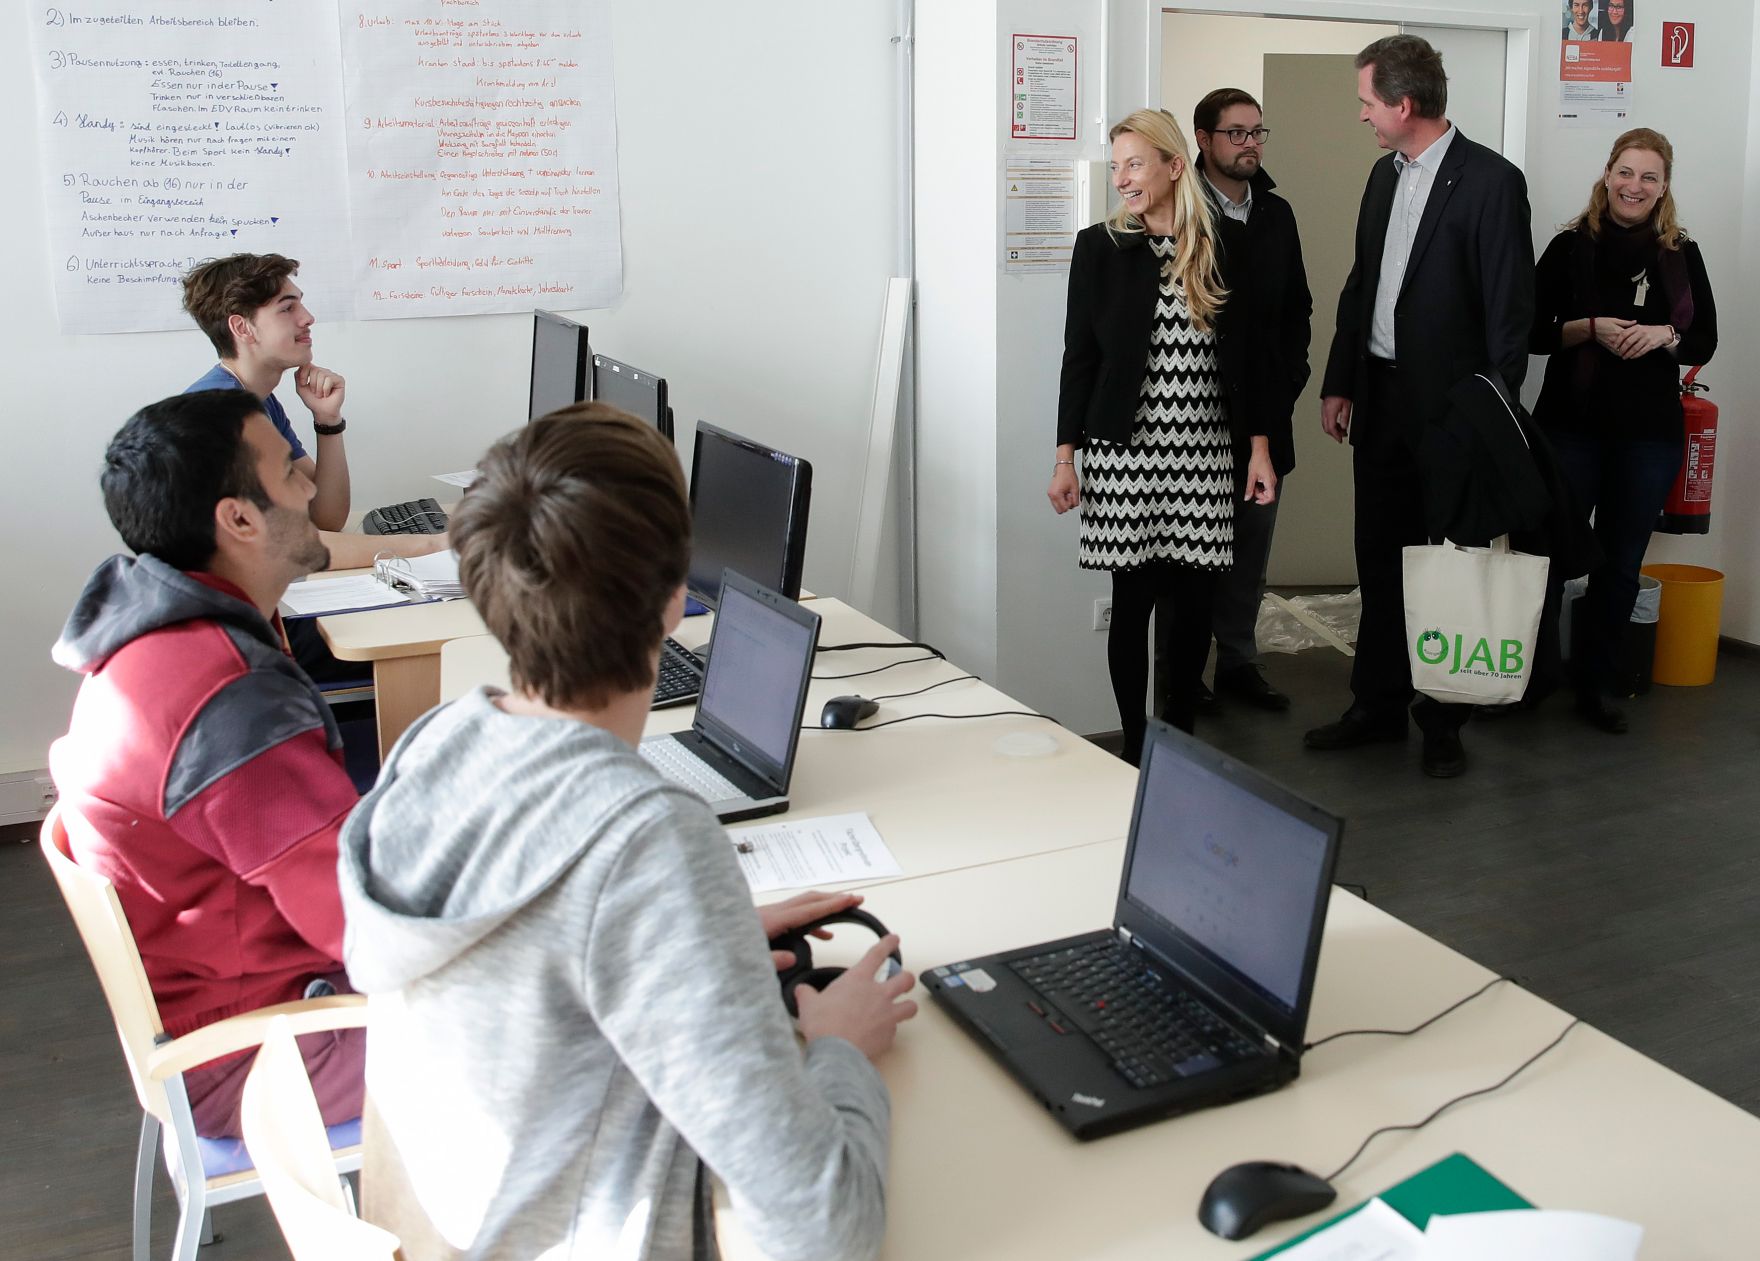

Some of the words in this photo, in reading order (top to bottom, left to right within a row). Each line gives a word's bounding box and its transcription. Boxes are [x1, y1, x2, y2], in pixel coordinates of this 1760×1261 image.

[46, 8, 64, 27] 2)
[69, 13, 82, 24] Im
[84, 14, 143, 25] zugeteilten
[149, 15, 214, 26] Arbeitsbereich
[218, 17, 259, 27] bleiben.
[49, 50, 66, 69] 3)
[168, 68, 205, 76] Rauchen
[208, 69, 222, 78] (16)
[151, 79, 183, 89] Essen
[149, 93, 181, 101] Trinken
[211, 105, 233, 113] EDV
[235, 105, 261, 113] Raum
[53, 110, 68, 127] 4)
[129, 134, 155, 144] Musik
[160, 136, 183, 144] hören
[172, 147, 197, 156] Beim
[64, 174, 75, 186] 5)
[79, 173, 138, 187] Rauchen
[143, 178, 159, 187] ab
[164, 177, 181, 190] (16)
[185, 181, 205, 189] nur
[227, 178, 248, 190] der
[79, 191, 112, 204] Pause
[81, 211, 144, 222] Aschenbecher
[161, 228, 185, 236] nach
[67, 255, 79, 271] 6)
[86, 258, 183, 270] Unterrichtssprache
